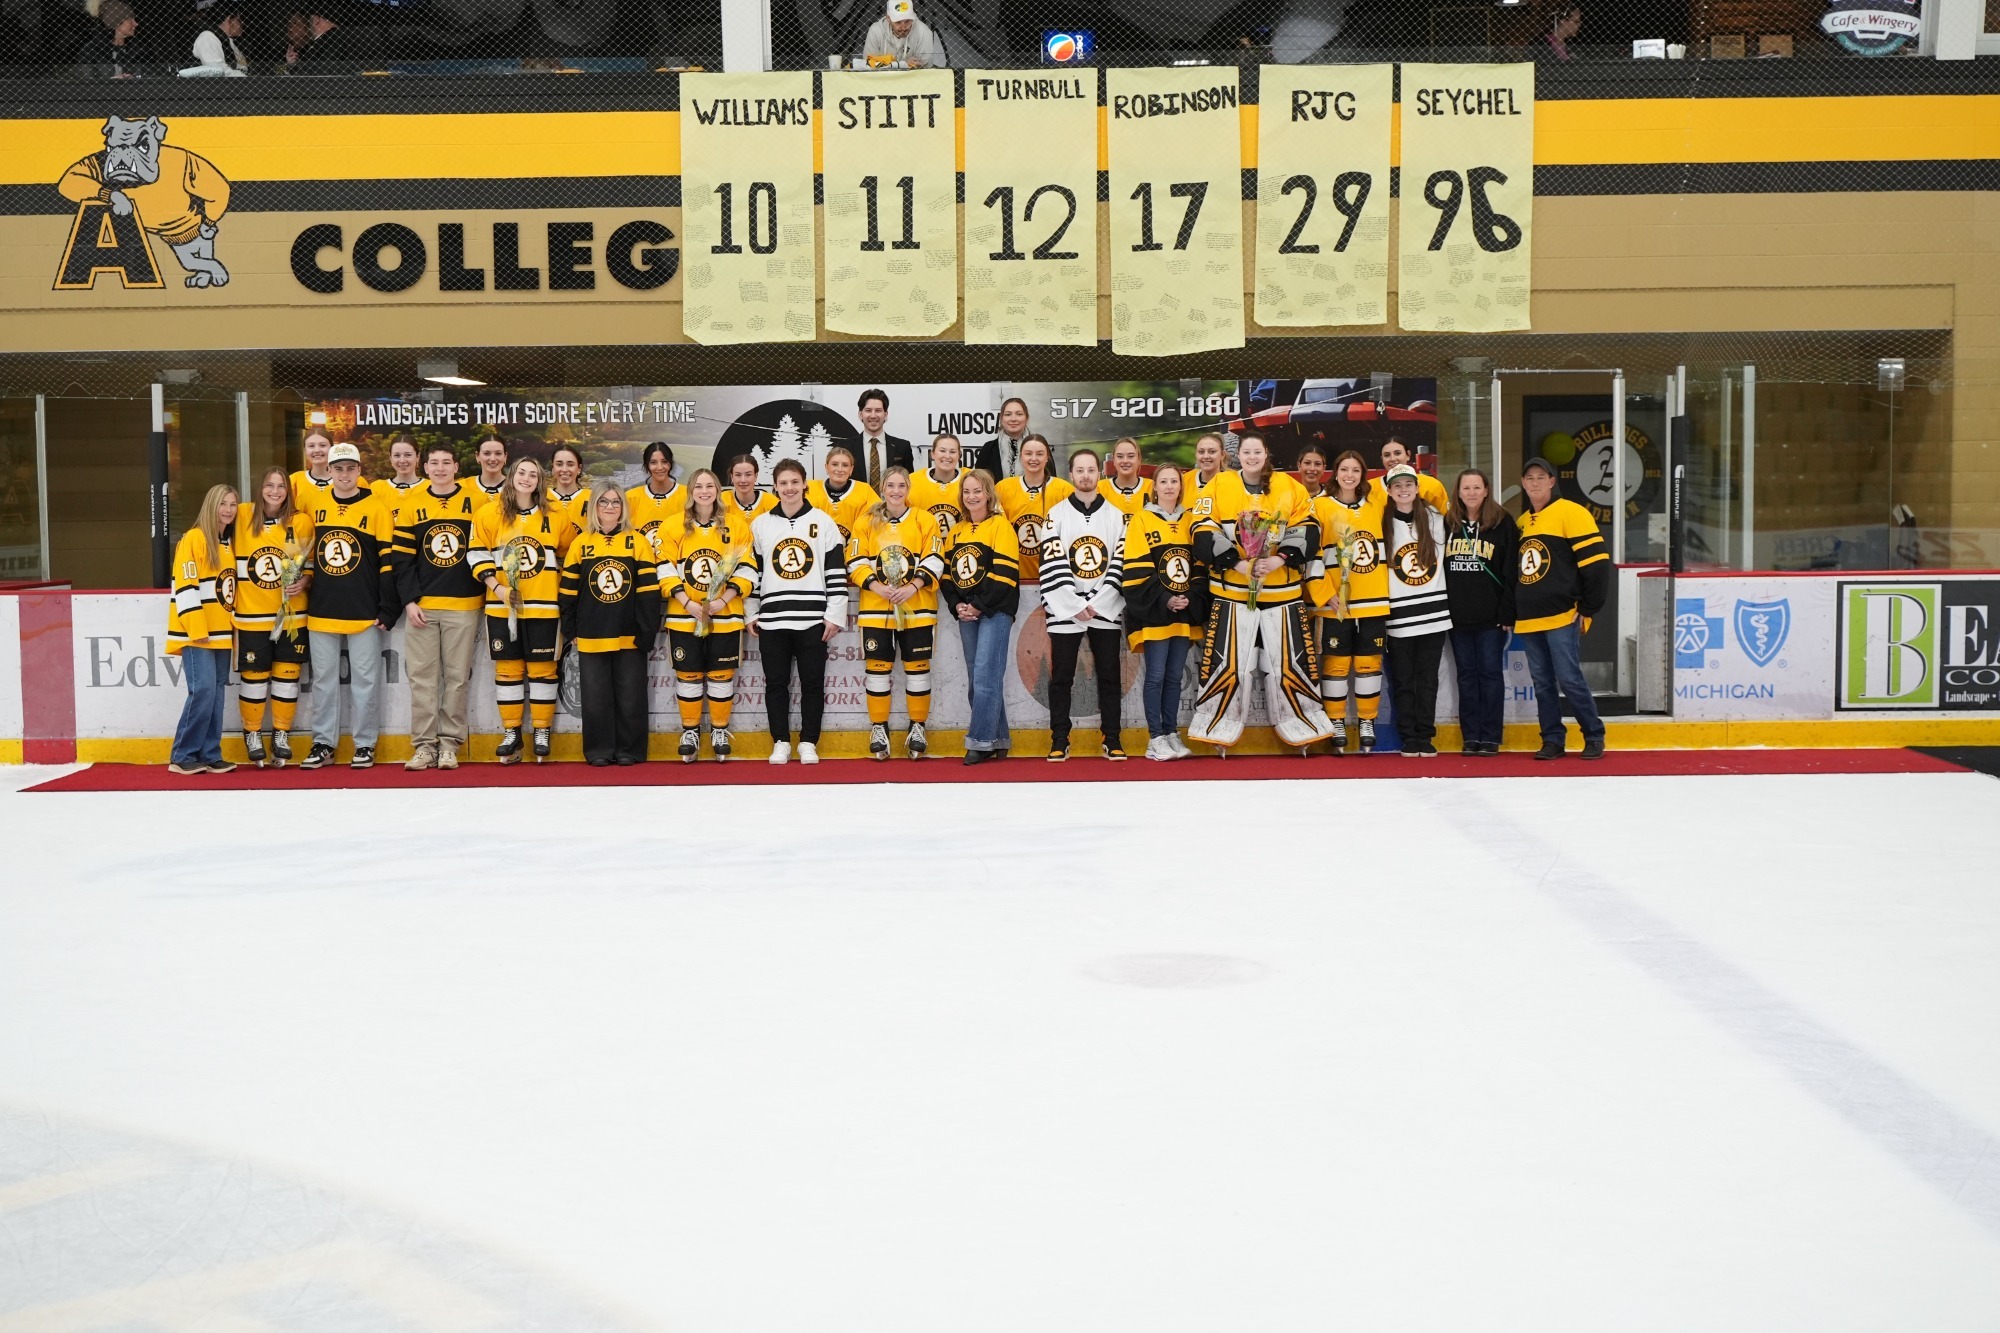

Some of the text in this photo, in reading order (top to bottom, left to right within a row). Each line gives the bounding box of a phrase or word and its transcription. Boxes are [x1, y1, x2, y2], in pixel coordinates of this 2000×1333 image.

[1832, 15, 1859, 27] Cafe
[1868, 14, 1918, 32] Wingery
[977, 78, 1086, 101] TURNBULL
[1114, 86, 1236, 119] ROBINSON
[1291, 90, 1356, 122] RJG
[1416, 88, 1521, 116] SEYCHEL
[692, 98, 808, 126] WILLIAMS
[838, 94, 940, 130] STITT
[710, 181, 778, 254] 10
[859, 175, 920, 252] 11
[1130, 181, 1209, 252] 17
[1278, 171, 1372, 255] 29
[983, 184, 1080, 261] 12
[52, 197, 166, 290] A
[290, 220, 680, 293] COLLEG
[355, 401, 697, 426] LANDSCAPES THAT SCORE EVERY TIME
[462, 496, 472, 514] A
[1194, 498, 1212, 514] 29
[315, 510, 326, 524] 10
[359, 516, 368, 530] A
[416, 508, 428, 522] 11
[429, 525, 462, 537] BULLDOGS
[541, 516, 550, 534] A
[809, 524, 818, 538] C
[285, 526, 295, 544] A
[324, 530, 355, 544] BULLDOGS
[625, 536, 634, 550] C
[722, 526, 730, 544] C
[1073, 536, 1104, 550] BULLDOGS
[1145, 531, 1162, 546] 29
[582, 545, 594, 558] 12
[778, 538, 807, 552] BULLDOGS
[931, 536, 944, 552] 17
[955, 546, 980, 558] BULLDOGS
[1042, 540, 1065, 560] 29
[1398, 544, 1418, 558] BULLD
[1446, 538, 1495, 560] ADRIAN
[432, 557, 458, 566] ADRIAN
[595, 560, 626, 572] BULLDOGS
[1352, 564, 1376, 573] ADRIAN
[1450, 561, 1486, 572] HOCKEY
[182, 560, 197, 580] 10
[324, 565, 350, 575] ADRIAN
[780, 570, 806, 579] ADRIAN
[1076, 570, 1102, 578] ADRIAN
[1404, 574, 1430, 586] ADRIAN
[600, 592, 622, 602] ADRIAN
[1201, 630, 1216, 680] VAUGHN
[1303, 633, 1318, 680] VAUGHN
[1675, 684, 1774, 700] MICHIGAN
[1945, 690, 1990, 703] Landscape
